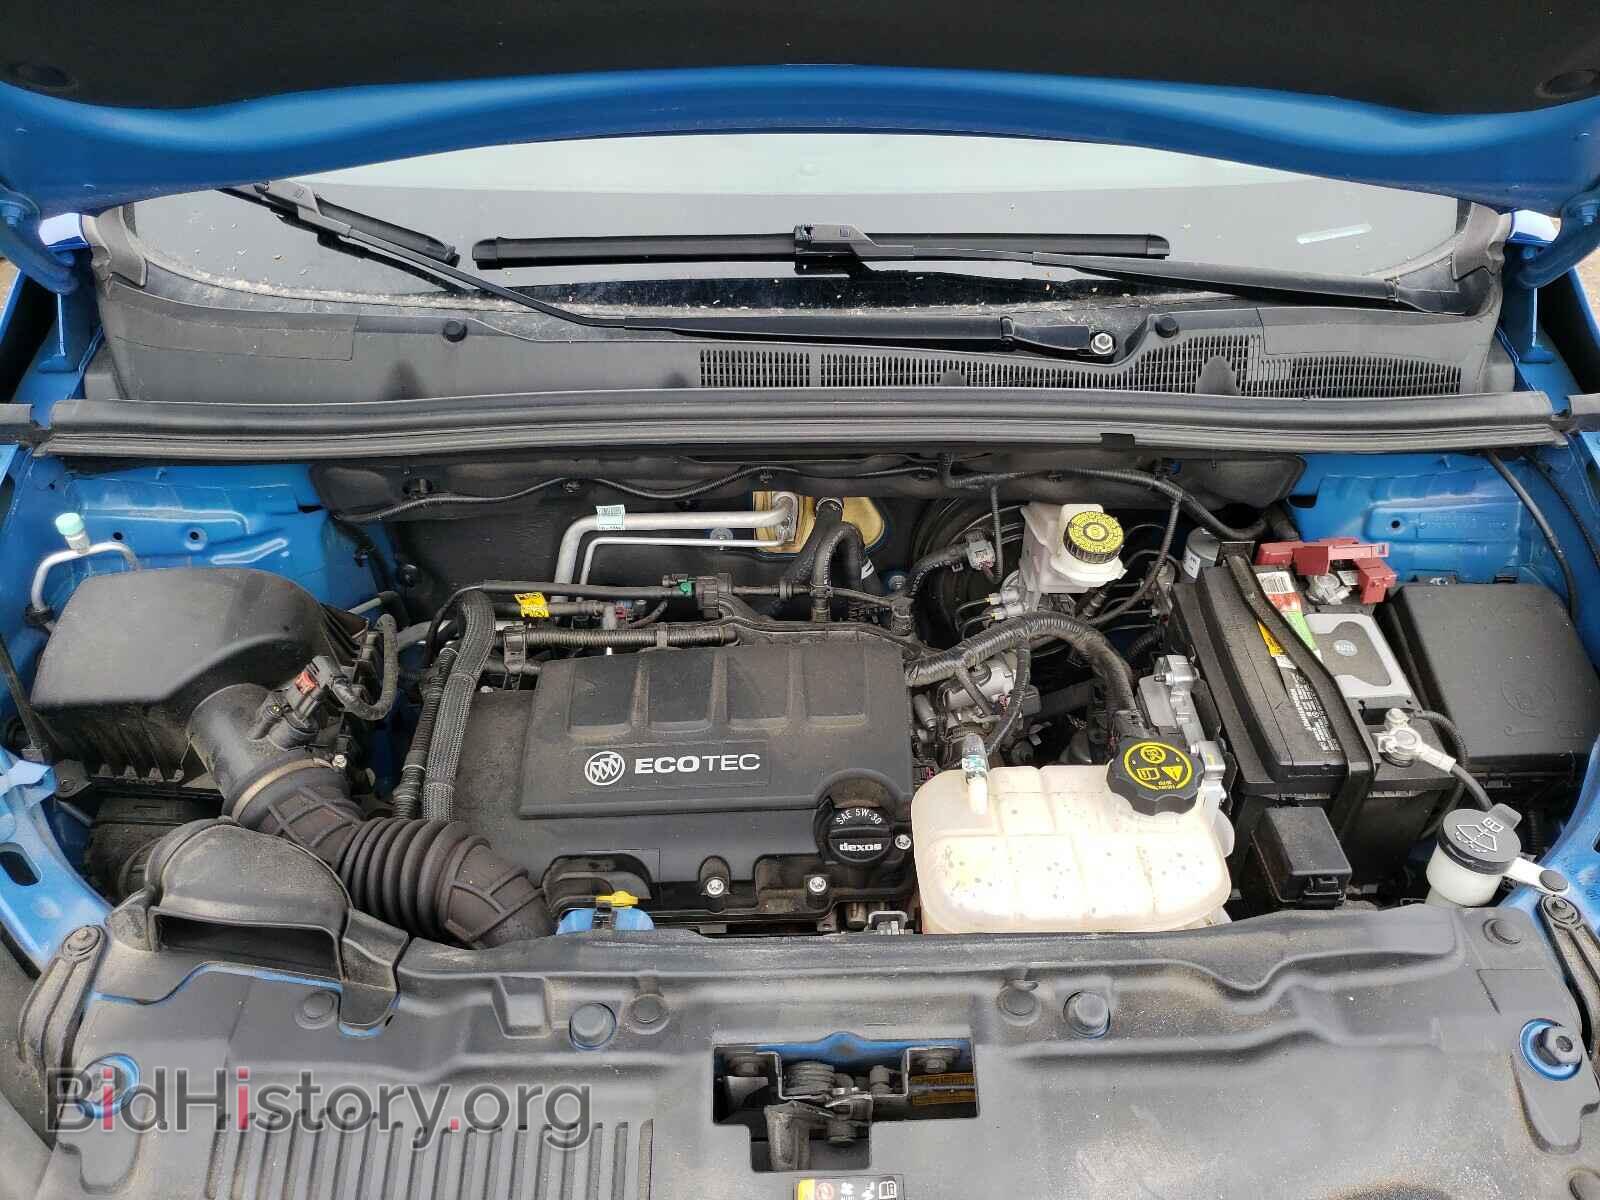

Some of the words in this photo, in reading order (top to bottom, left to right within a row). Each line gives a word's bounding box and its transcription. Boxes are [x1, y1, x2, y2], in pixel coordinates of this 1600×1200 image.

[634, 754, 761, 774] ECOTEC
[836, 810, 852, 824] SAE
[855, 808, 881, 825] 5W-30
[839, 842, 882, 852] dexos
